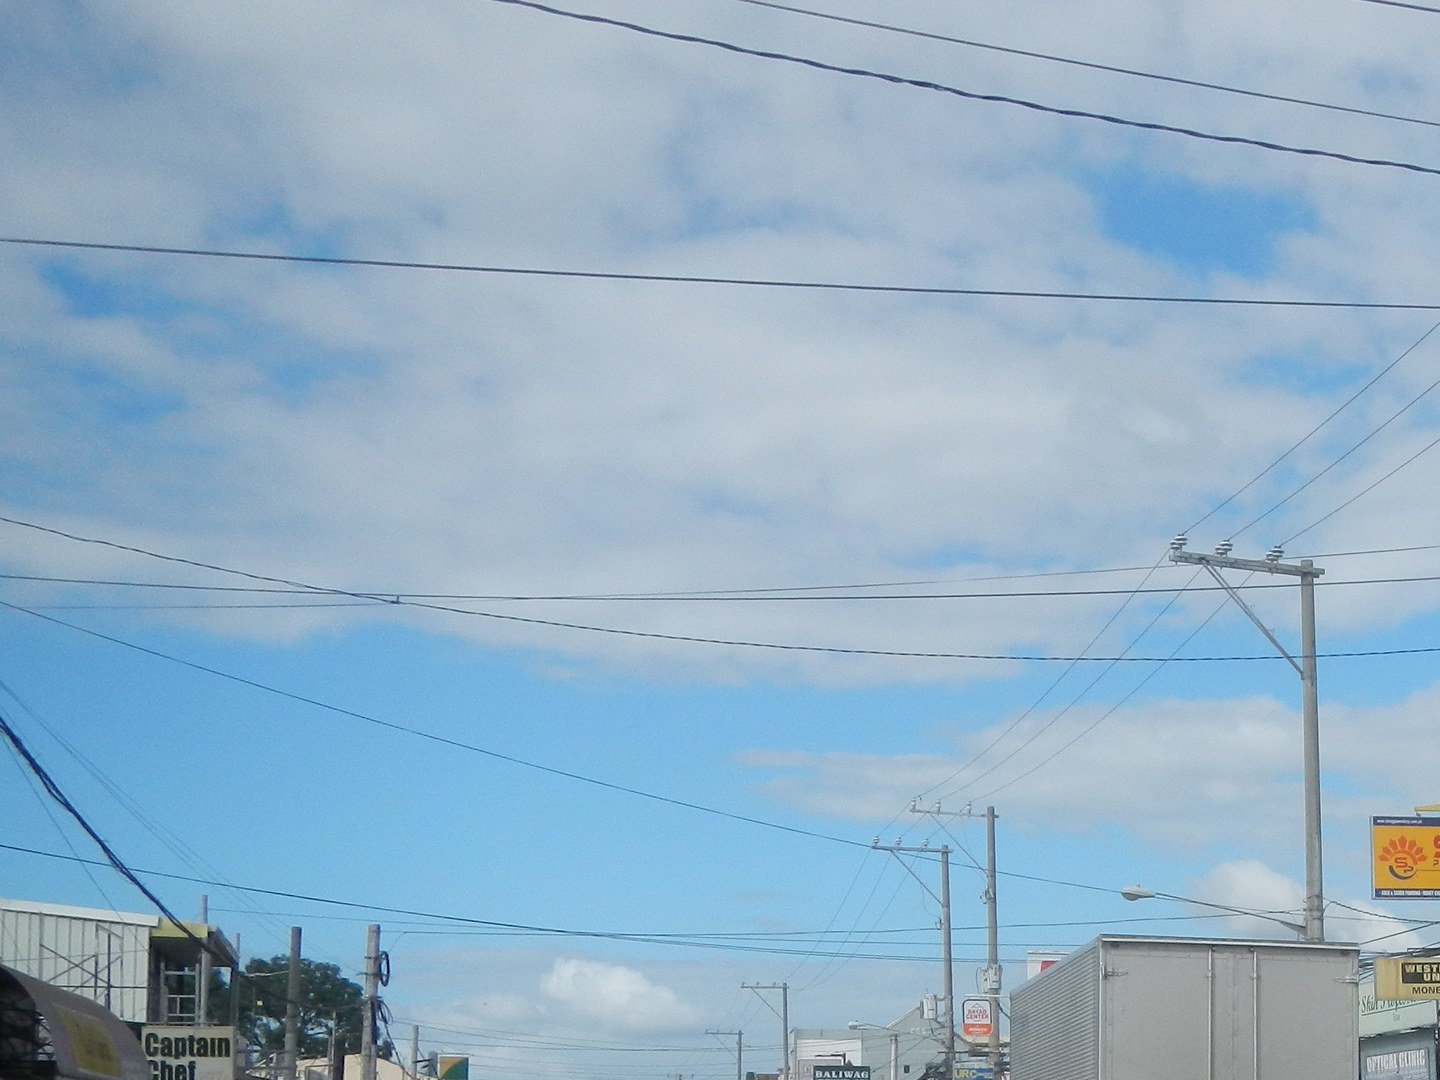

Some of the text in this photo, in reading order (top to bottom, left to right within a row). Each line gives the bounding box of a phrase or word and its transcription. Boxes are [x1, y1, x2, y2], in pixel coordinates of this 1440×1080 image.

[145, 1033, 231, 1059] Captain
[1366, 1049, 1426, 1072] OPTICAL CLINIC
[815, 1071, 869, 1079] BALIWAG
